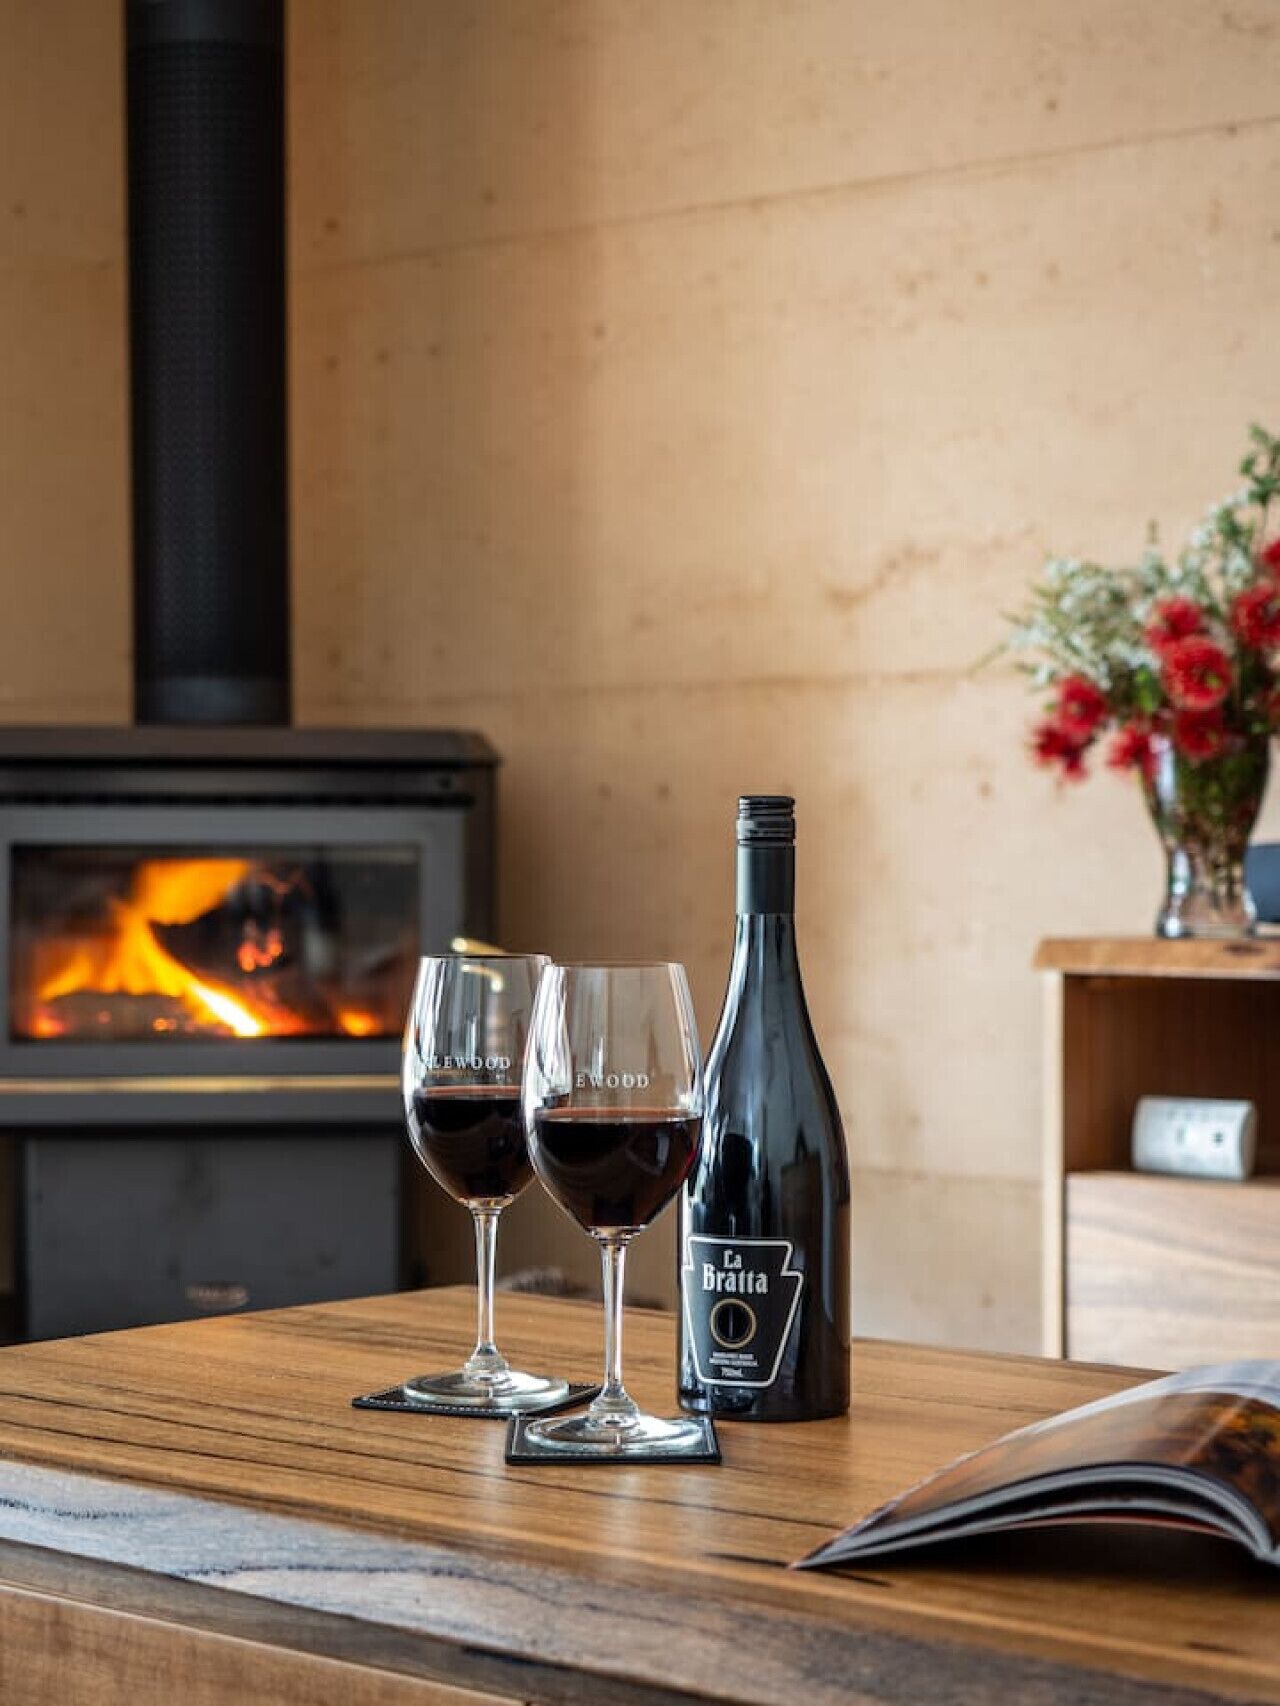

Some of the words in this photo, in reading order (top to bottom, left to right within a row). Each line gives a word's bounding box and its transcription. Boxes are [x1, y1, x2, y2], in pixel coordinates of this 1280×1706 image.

[425, 1055, 512, 1069] LEWOOD
[575, 1073, 650, 1089] EWOOD
[702, 1263, 769, 1294] Bratta
